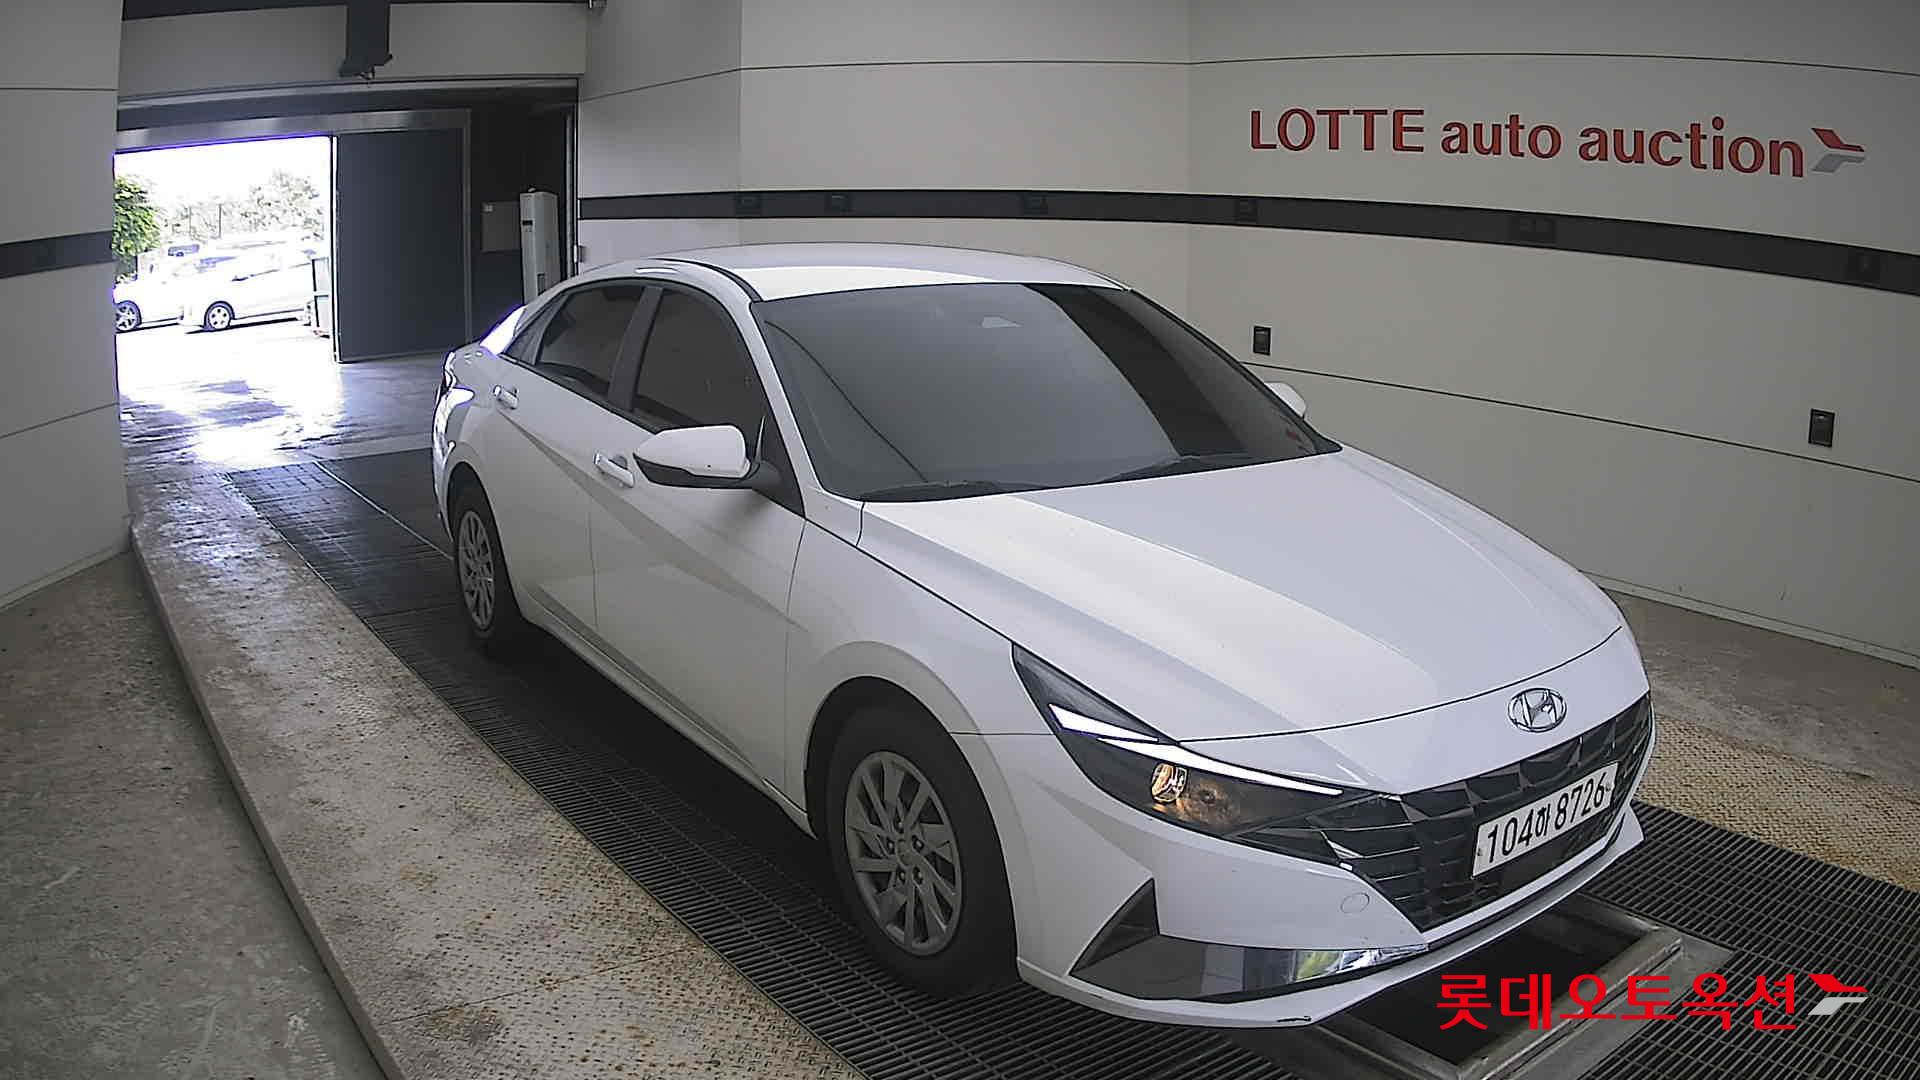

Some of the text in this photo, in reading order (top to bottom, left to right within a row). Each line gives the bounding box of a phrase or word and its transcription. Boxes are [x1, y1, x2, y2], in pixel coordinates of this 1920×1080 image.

[1250, 109, 1804, 178] LOTTE auto auction
[1554, 771, 1608, 831] 8726
